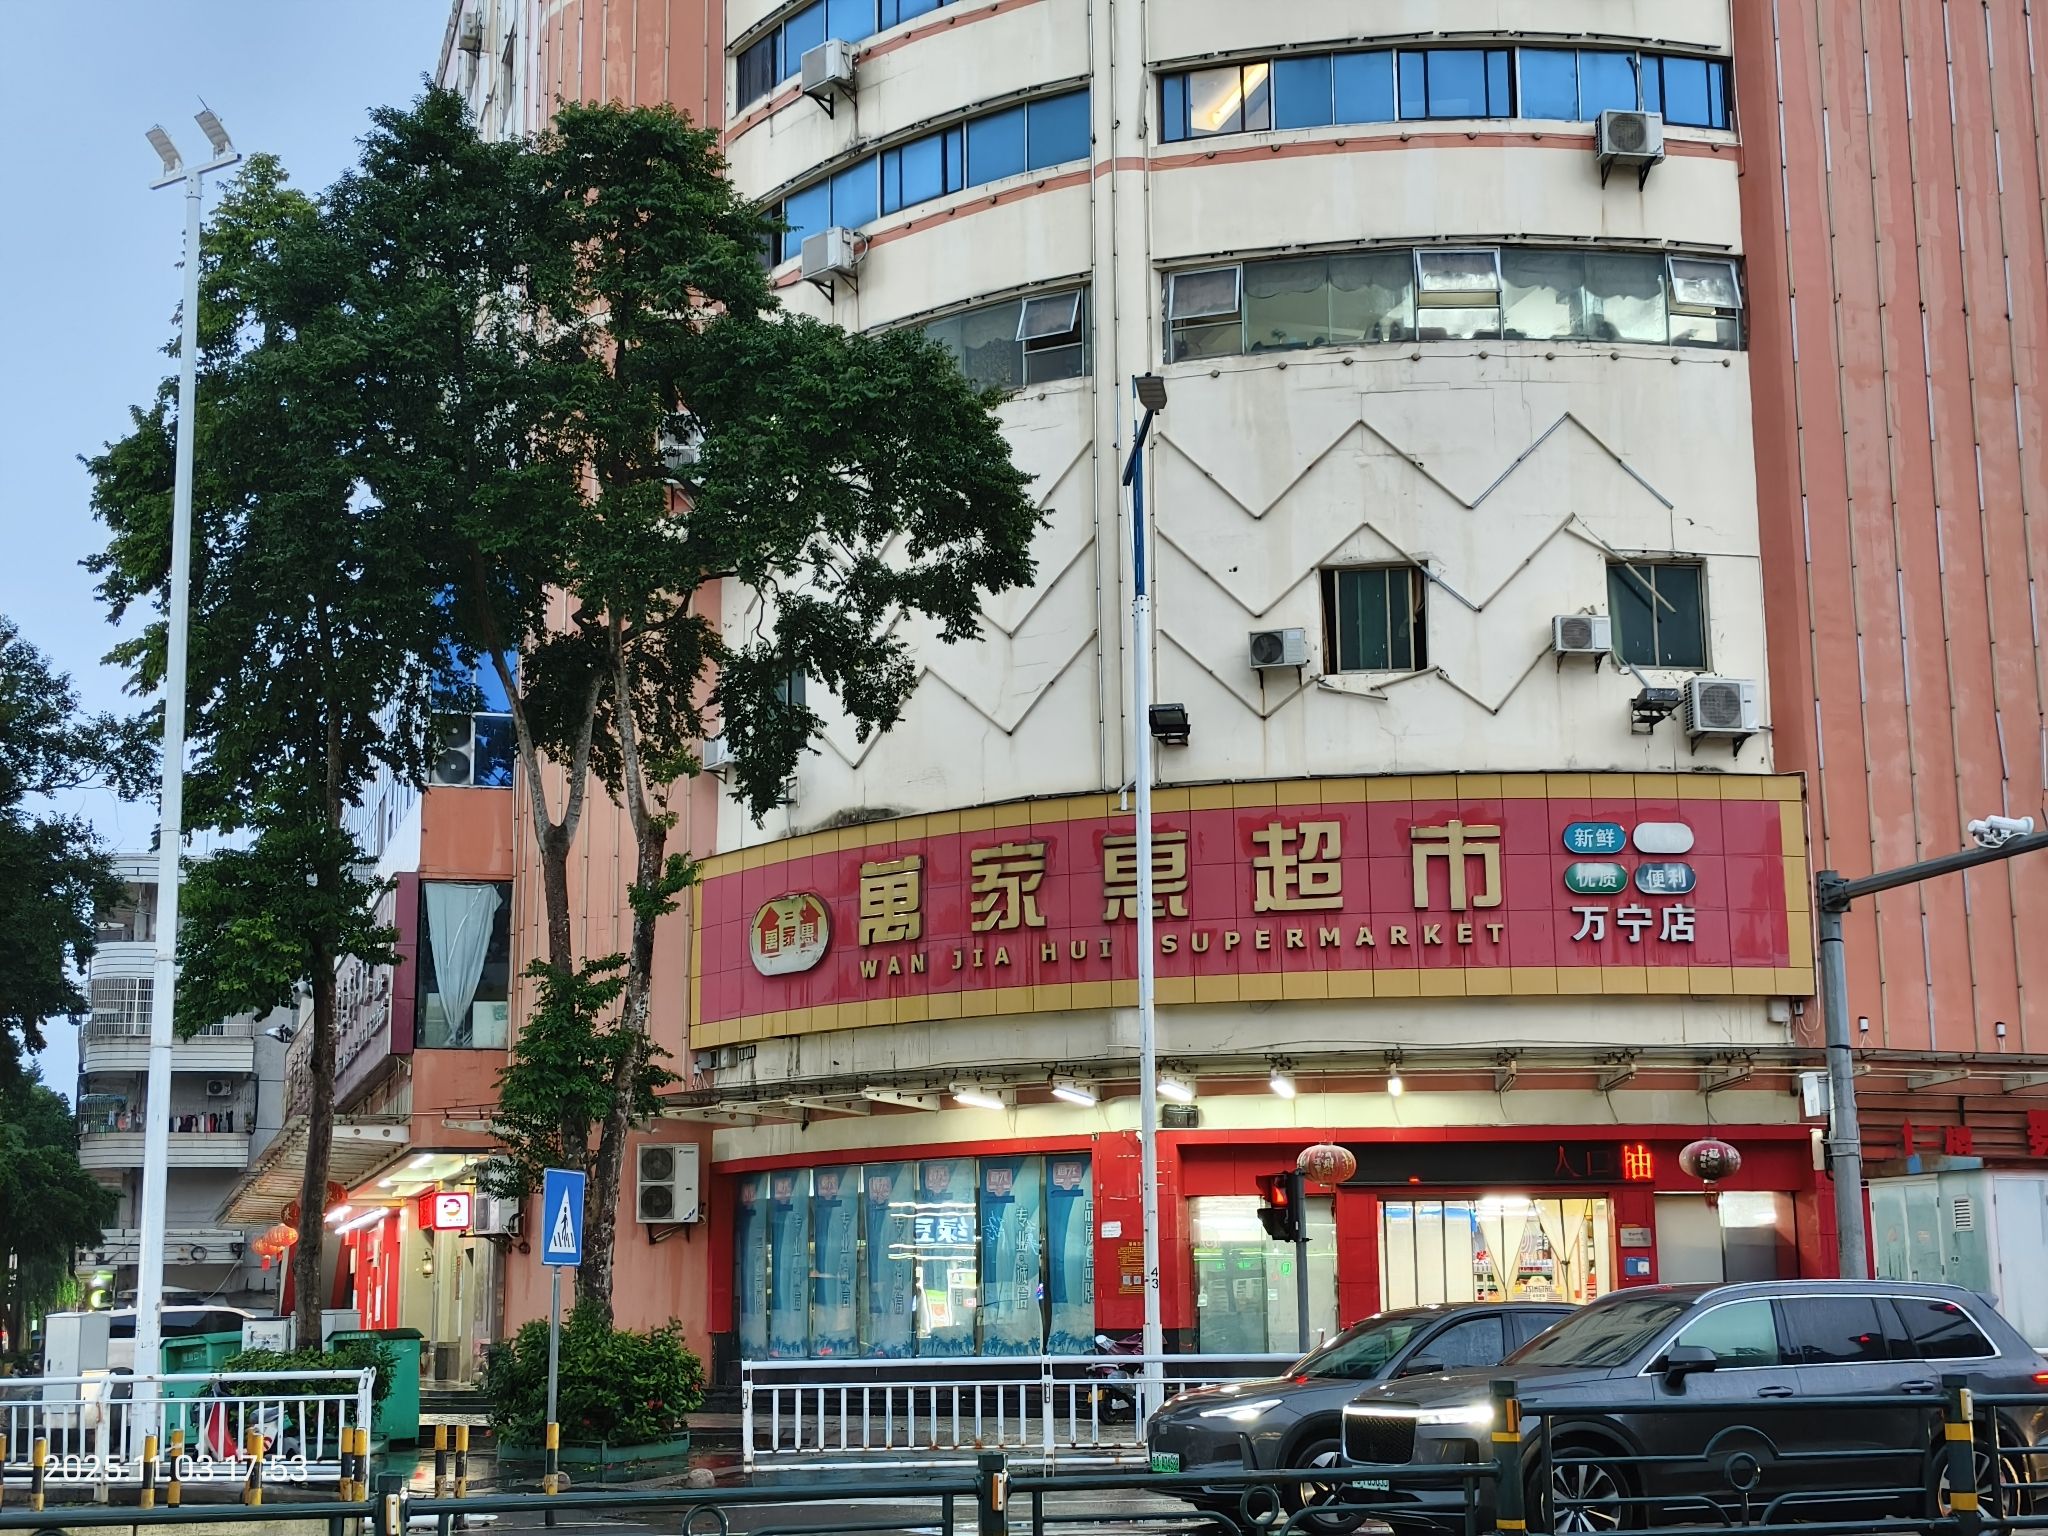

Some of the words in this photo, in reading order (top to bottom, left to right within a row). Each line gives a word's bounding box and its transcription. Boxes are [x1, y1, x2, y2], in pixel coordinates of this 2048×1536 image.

[1574, 828, 1616, 848] 新鲜
[1576, 868, 1617, 888] 优质
[1646, 868, 1688, 888] 便利
[1571, 903, 1696, 942] 万宁店
[860, 953, 925, 979] WAN
[952, 946, 1010, 970] JIA
[1041, 938, 1112, 962] HUI
[1161, 923, 1504, 953] SUPERMARKET
